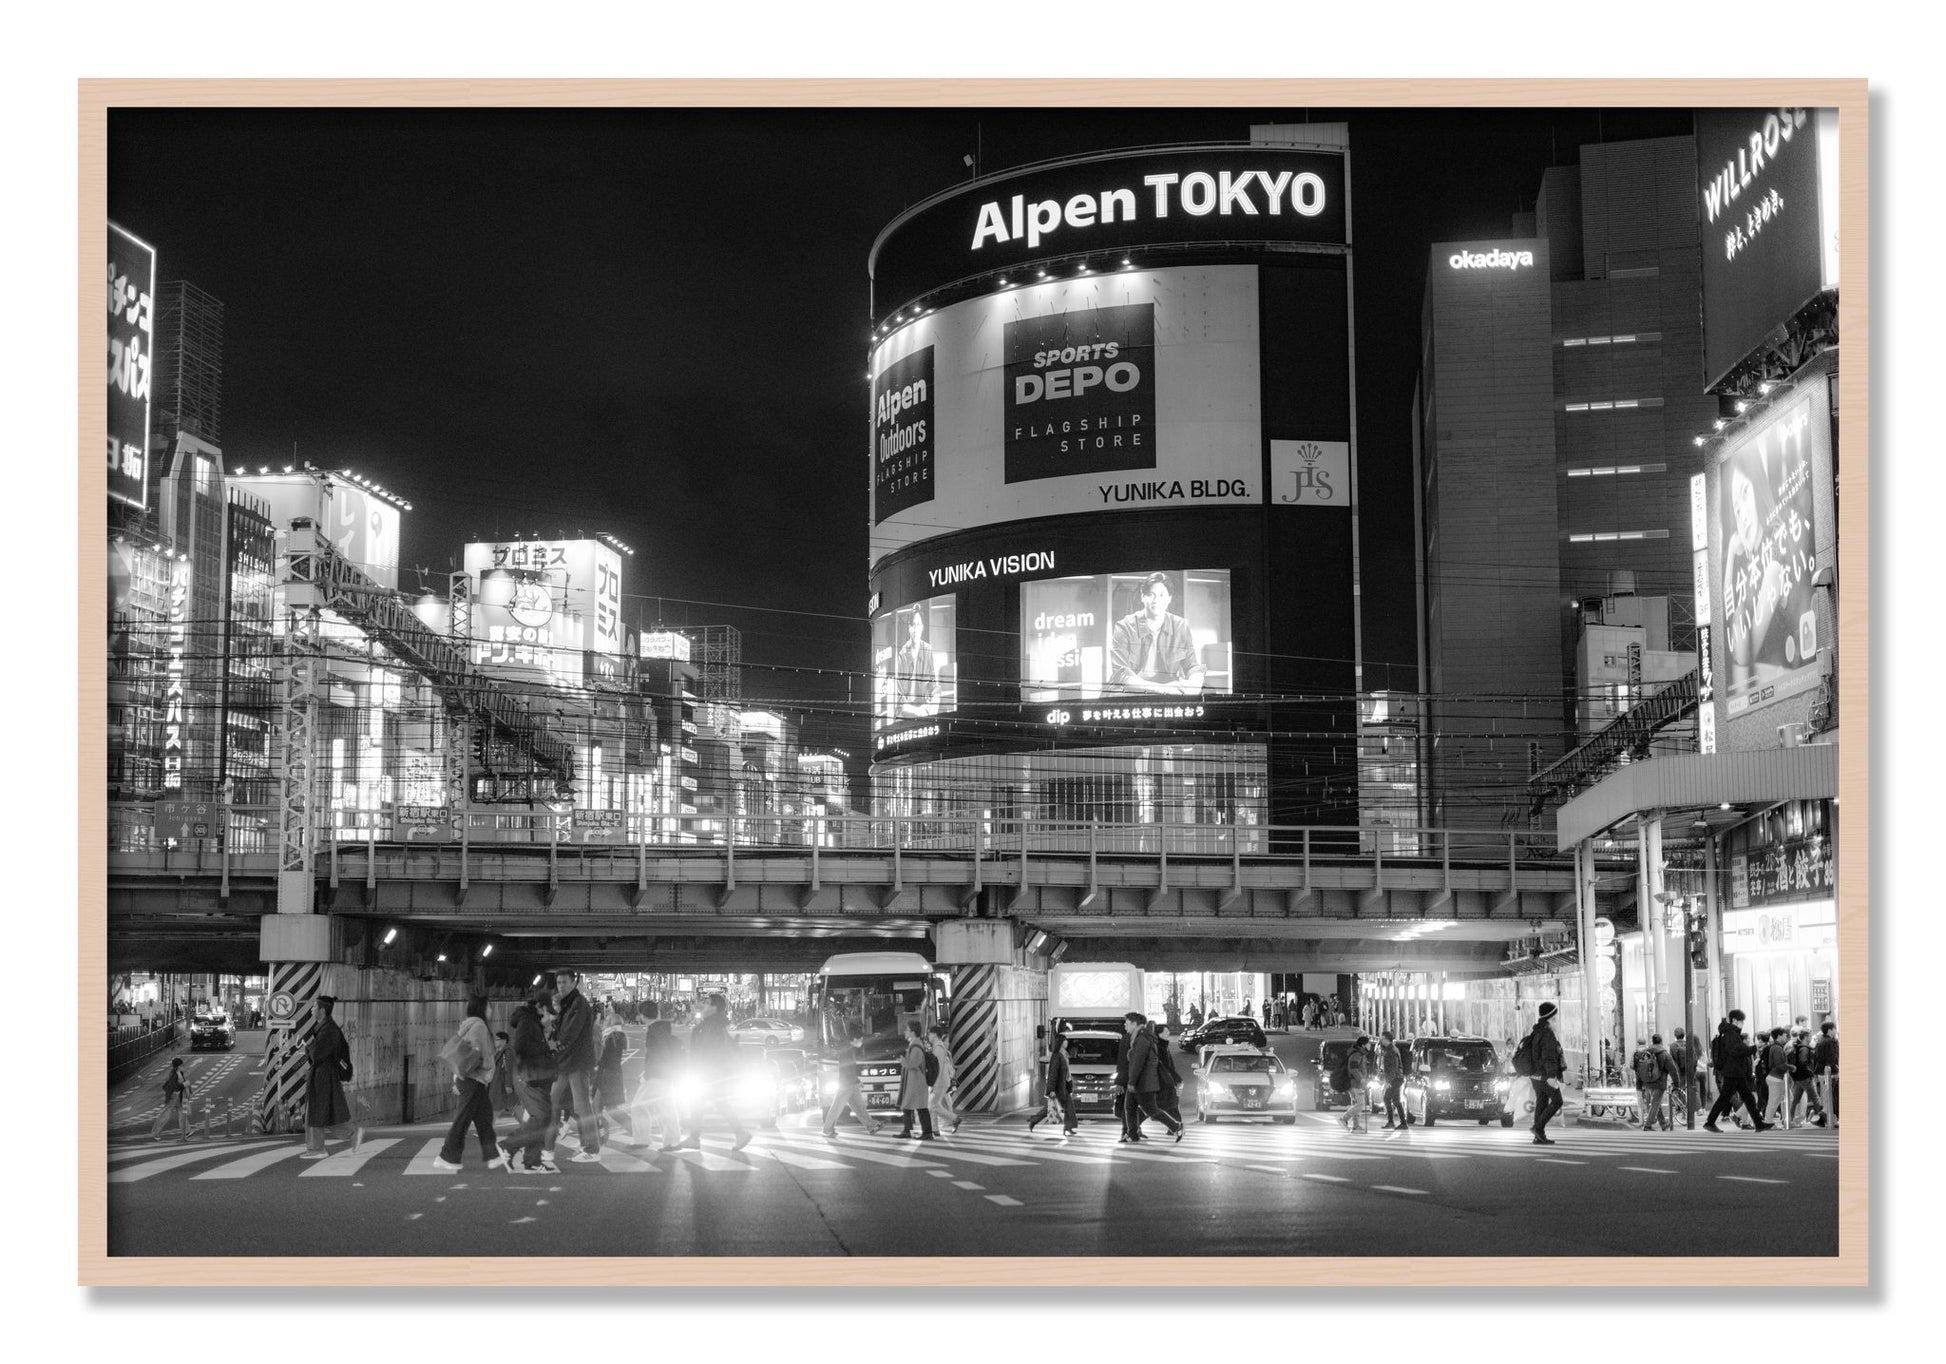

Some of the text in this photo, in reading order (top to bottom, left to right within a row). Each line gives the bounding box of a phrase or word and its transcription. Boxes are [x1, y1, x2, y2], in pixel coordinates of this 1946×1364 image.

[971, 171, 1326, 250] Alpen TOKYO
[1448, 249, 1534, 271] okadaya
[1033, 342, 1120, 369] SPORTS
[1015, 362, 1141, 405] DEPO
[877, 378, 927, 428] Alpen
[1015, 414, 1142, 440] FLAGSHIP
[880, 419, 926, 464] Outdoors
[1060, 433, 1142, 452] STORE
[876, 450, 928, 487] FLAGSHIP
[890, 468, 928, 494] STORE
[1098, 479, 1252, 503] YUNIKA BLDG.
[238, 551, 270, 574] SHISHA
[492, 544, 568, 567] プロミス
[1724, 509, 1811, 617] 自分本位でも、
[929, 551, 1056, 588] YUNIKA VISION
[1727, 547, 1816, 652] いいじゃない。
[1034, 611, 1095, 631] dream
[1046, 709, 1071, 725] dip
[1082, 706, 1205, 721] 夢を叶える仕事に出会おう
[399, 807, 448, 818] 新宿駅東口
[574, 810, 622, 820] 新宿駅東口
